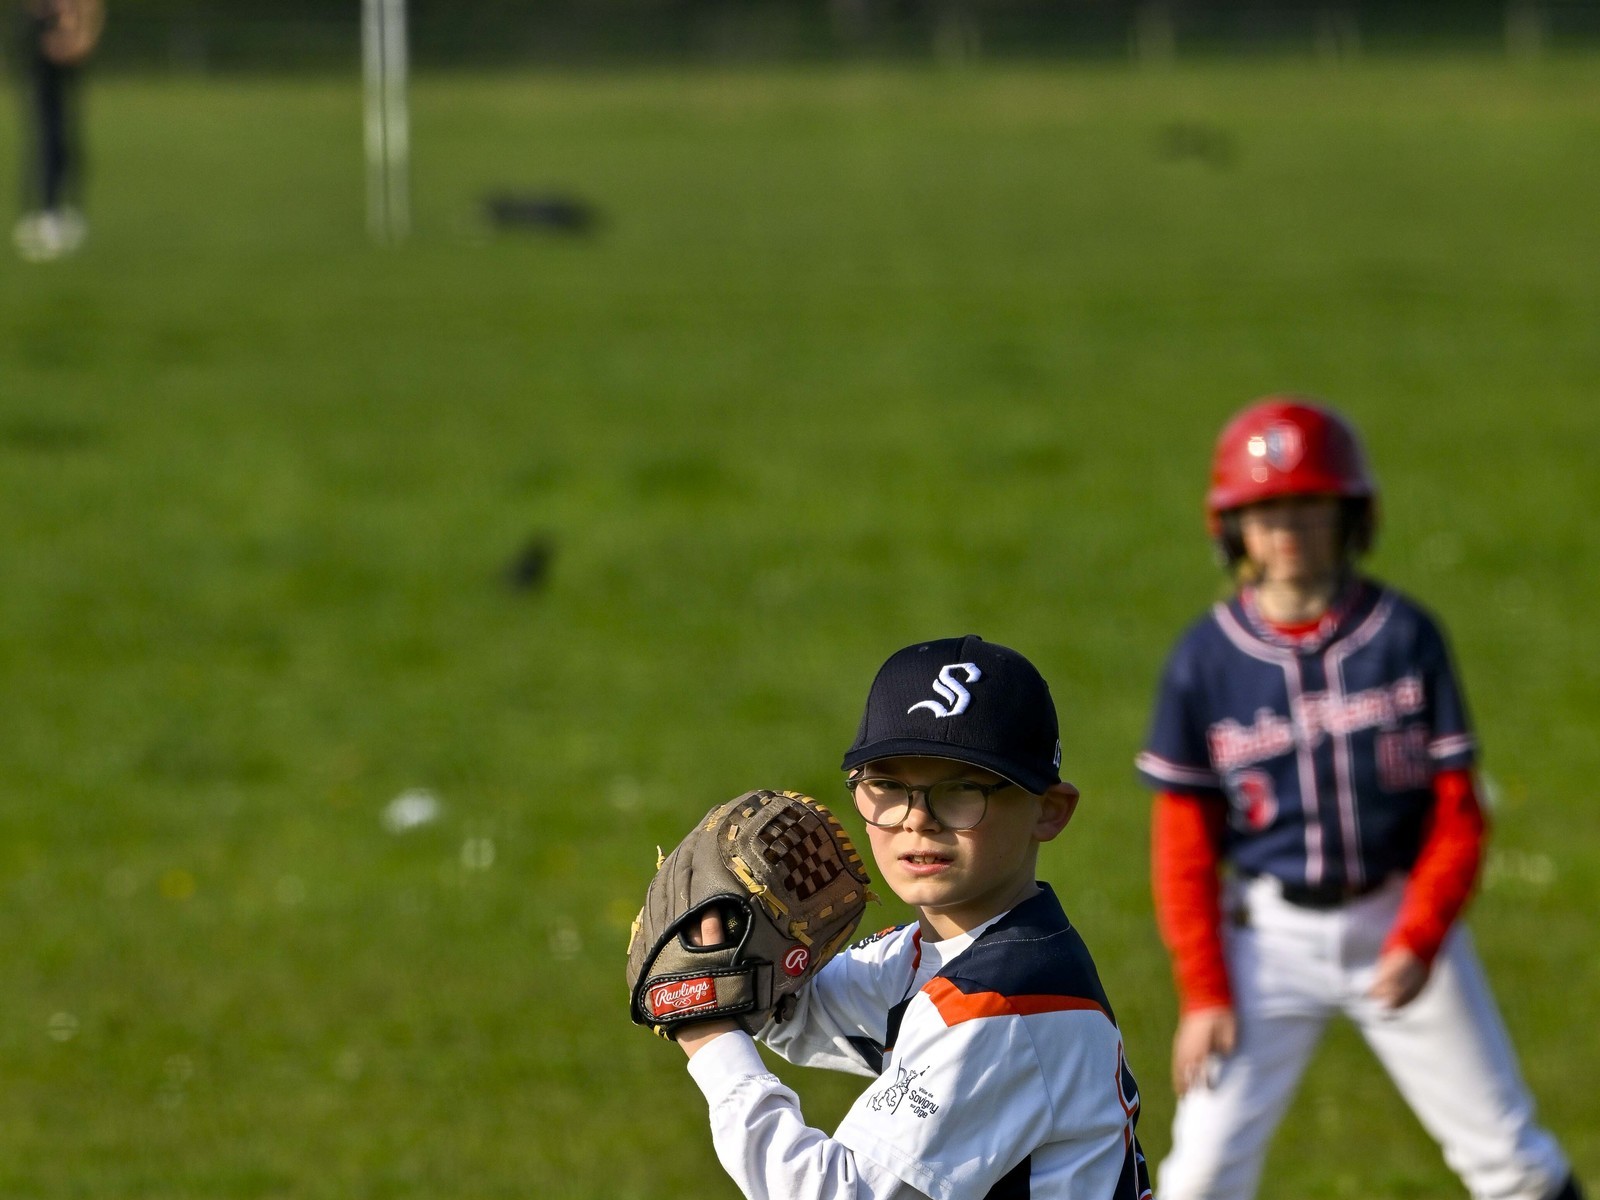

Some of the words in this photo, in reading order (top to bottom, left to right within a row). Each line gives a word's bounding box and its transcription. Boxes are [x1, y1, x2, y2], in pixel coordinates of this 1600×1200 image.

[907, 662, 982, 719] S
[785, 948, 808, 970] R
[655, 981, 710, 1007] Rawlings
[908, 1089, 940, 1115] Savigny
[913, 1106, 929, 1119] Orge
